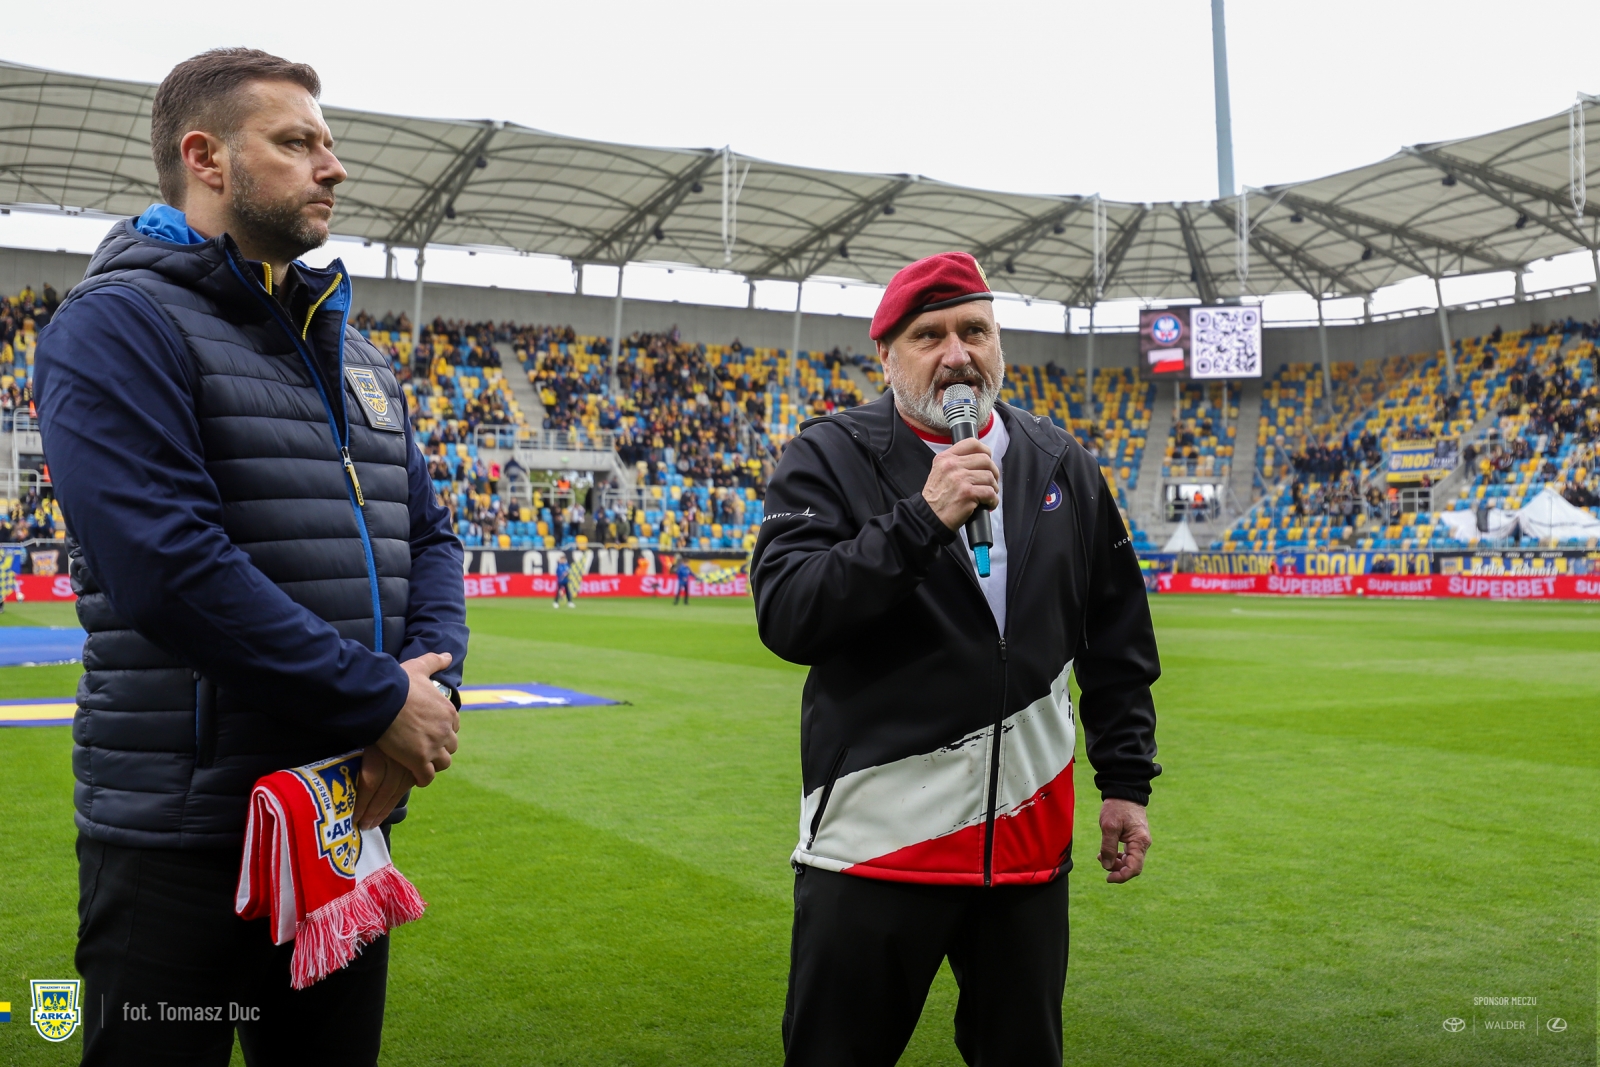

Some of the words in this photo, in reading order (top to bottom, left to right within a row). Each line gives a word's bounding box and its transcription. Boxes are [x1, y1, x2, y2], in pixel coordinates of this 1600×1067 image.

[1190, 577, 1256, 590] SUPERBET
[1268, 575, 1354, 594] SUPERBET
[1367, 578, 1432, 593] SUPERBET
[1448, 577, 1557, 598] SUPERBET
[331, 817, 352, 841] AR
